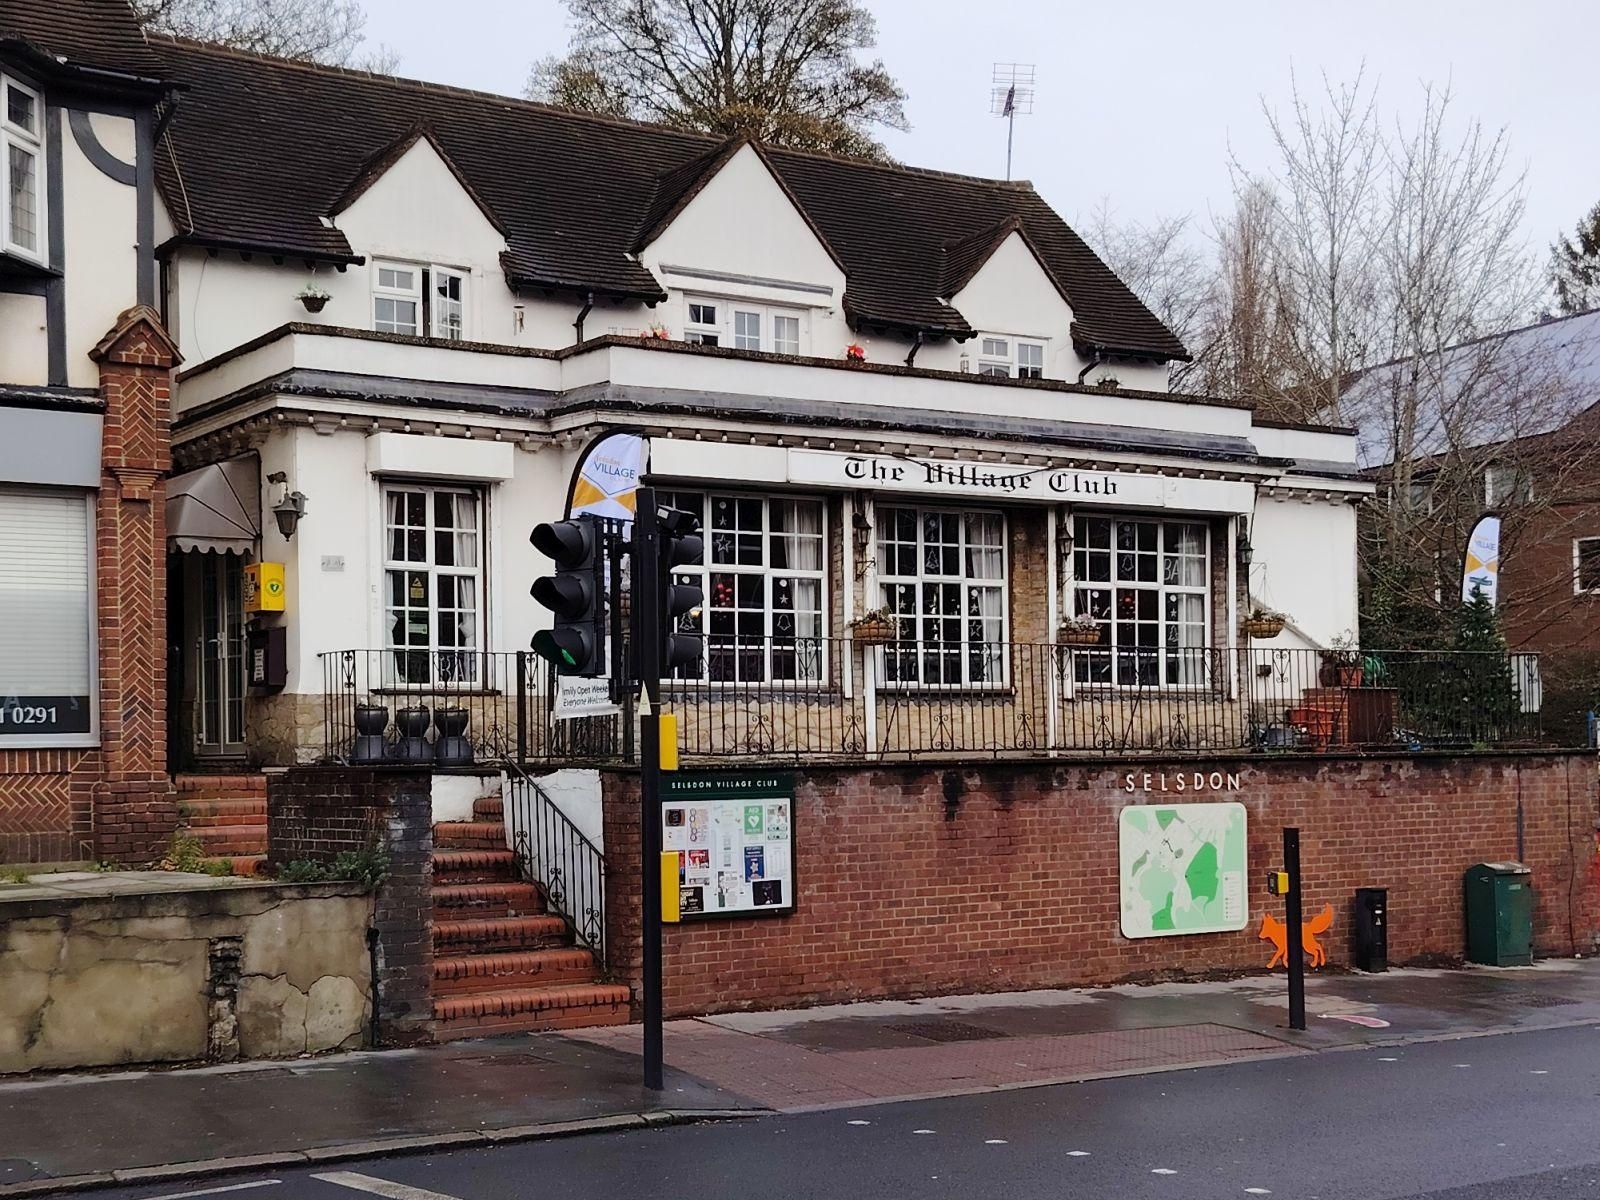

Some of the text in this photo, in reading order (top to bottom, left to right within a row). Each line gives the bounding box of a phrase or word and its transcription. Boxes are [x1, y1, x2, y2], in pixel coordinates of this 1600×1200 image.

[594, 460, 636, 479] VILLAGE
[845, 456, 1118, 496] The Village Club
[577, 686, 590, 696] Open
[12, 706, 57, 724] 0291
[671, 781, 712, 789] SELSDON
[716, 780, 752, 788] VILLAGE
[1125, 772, 1240, 792] SELSDON
